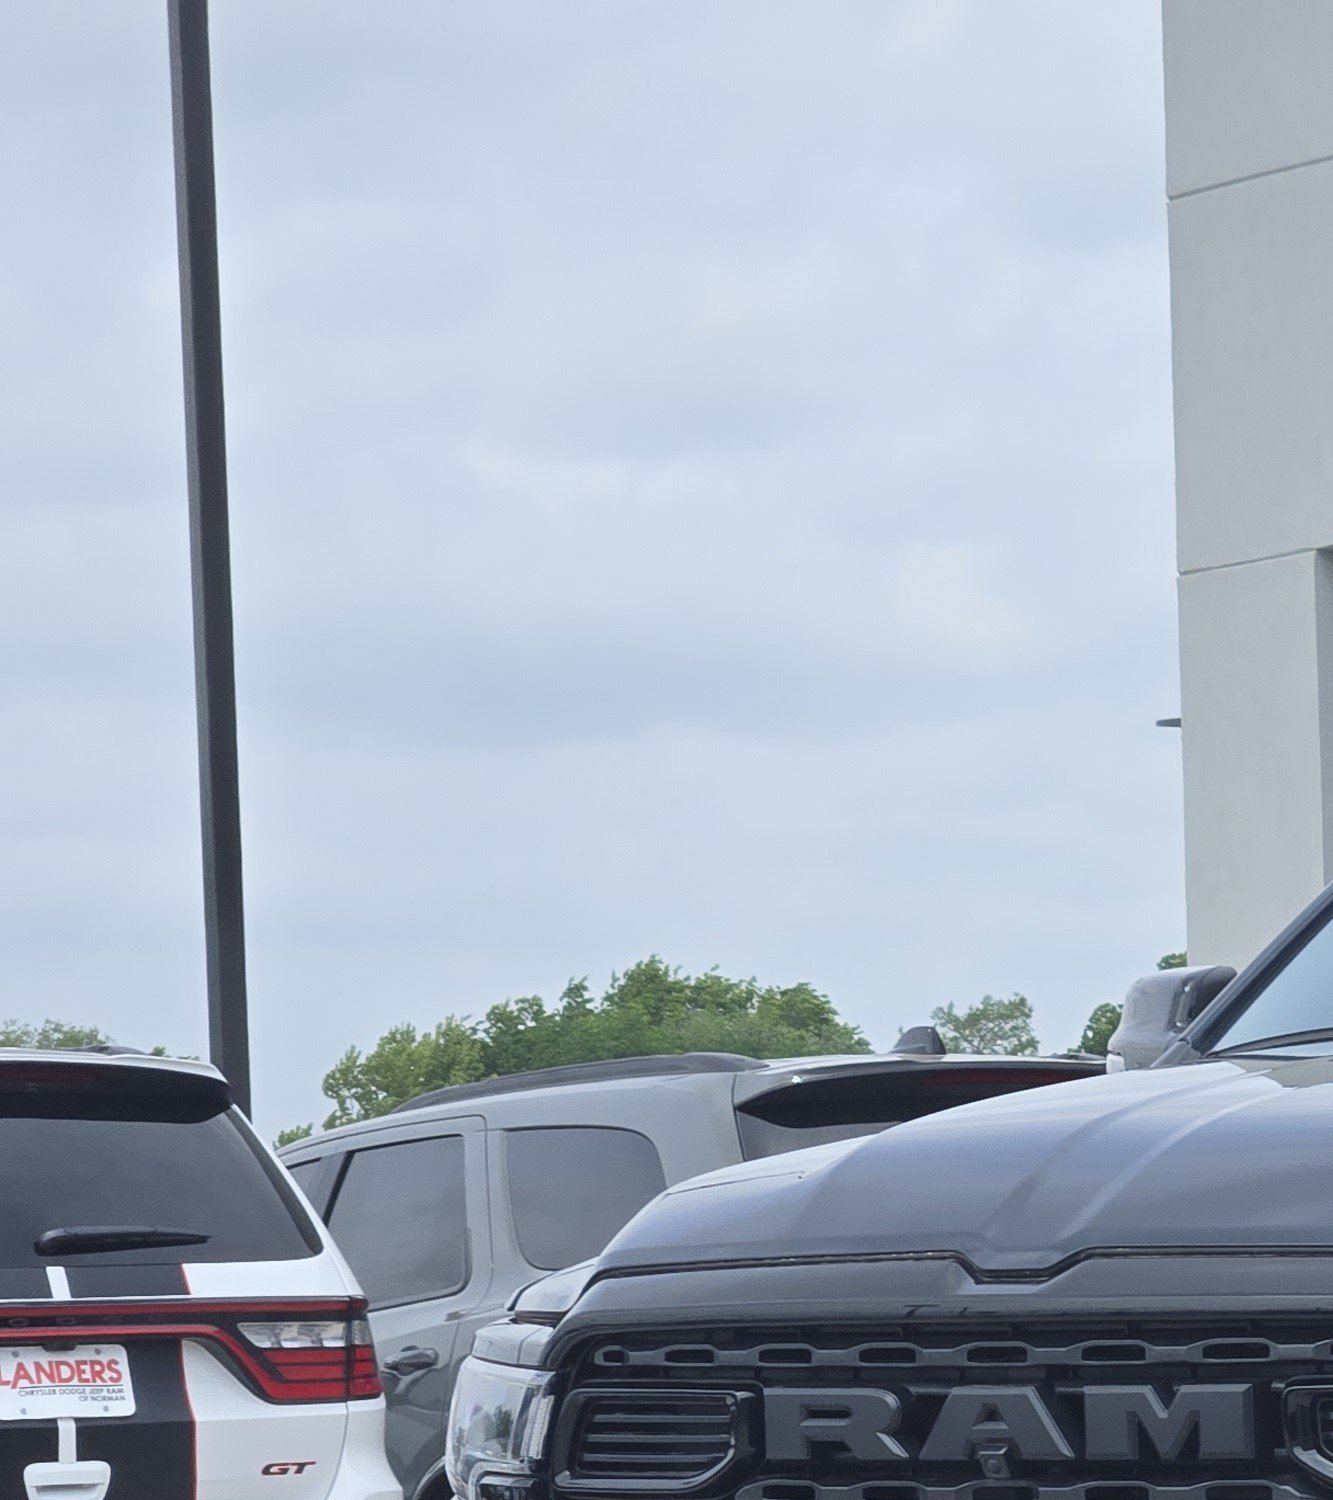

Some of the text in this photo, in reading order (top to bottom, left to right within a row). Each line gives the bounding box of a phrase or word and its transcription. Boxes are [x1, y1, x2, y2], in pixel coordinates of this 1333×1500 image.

[18, 1388, 57, 1398] CHRYSLER
[58, 1387, 87, 1396] DODGE
[106, 1387, 124, 1395] RAM
[763, 1384, 1255, 1460] RAM
[261, 1460, 317, 1476] GT
